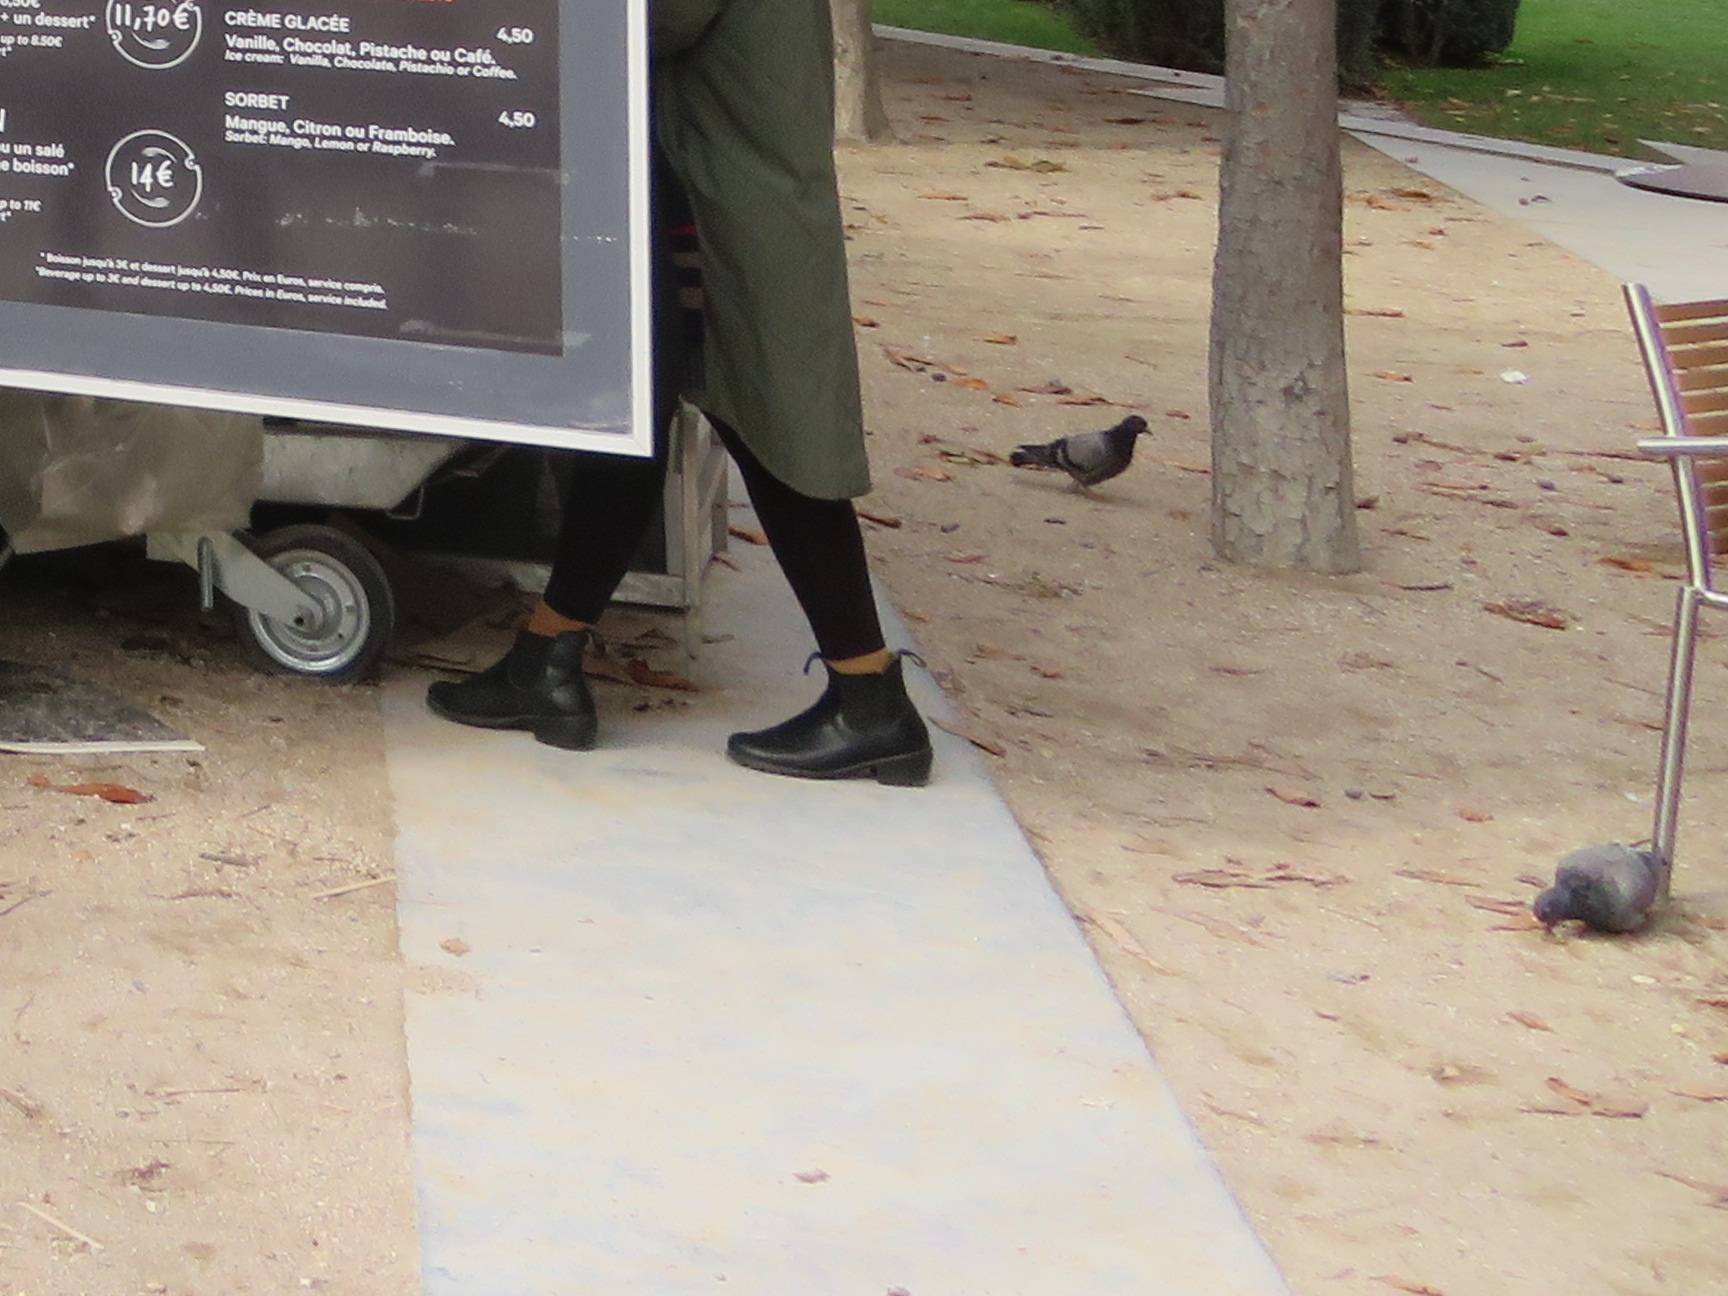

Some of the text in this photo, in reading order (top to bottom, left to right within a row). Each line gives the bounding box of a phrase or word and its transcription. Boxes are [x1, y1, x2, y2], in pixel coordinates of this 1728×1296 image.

[225, 10, 349, 33] CRÈME GLACÉE
[497, 28, 533, 44] 4,50
[225, 92, 289, 109] SORBET
[499, 111, 535, 128] 4,50
[131, 160, 174, 192] 14€
